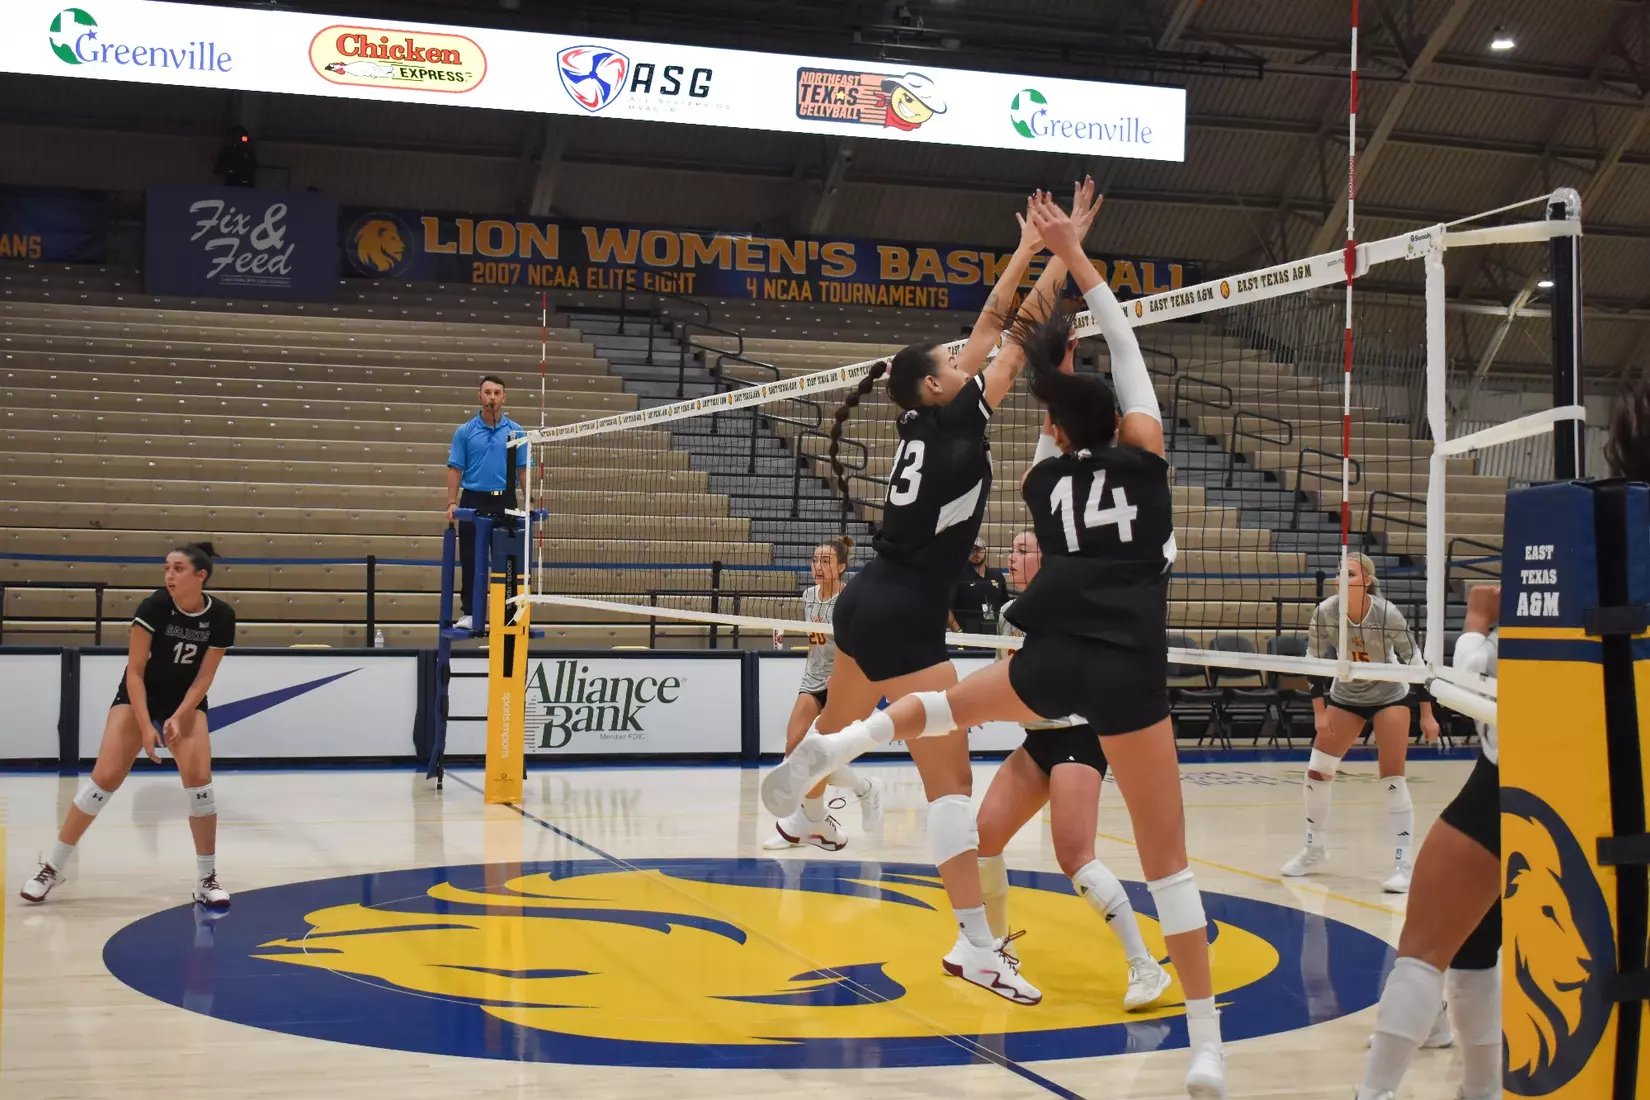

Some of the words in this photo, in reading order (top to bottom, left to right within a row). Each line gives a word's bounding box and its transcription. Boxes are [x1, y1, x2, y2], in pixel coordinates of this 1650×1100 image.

[75, 32, 232, 73] Greenville
[336, 33, 462, 65] Chicken
[400, 67, 464, 82] EXPRESS
[630, 63, 713, 98] ASG
[800, 71, 861, 86] NORTHEAST
[800, 84, 859, 106] TEXAS
[800, 104, 859, 120] GELLYBALL
[1031, 110, 1153, 144] Greenville
[189, 199, 251, 242] Fix
[250, 203, 288, 250] &
[204, 237, 295, 279] Feed
[421, 216, 559, 260] LION
[581, 226, 857, 278] WOMEN'S
[472, 261, 521, 285] 2007
[528, 264, 580, 288] NCAA
[587, 267, 637, 291] ELITE
[643, 271, 697, 294] EIGHT
[746, 276, 757, 299] 4
[764, 278, 813, 301] NCAA
[818, 281, 949, 308] TOURNAMENTS
[1237, 276, 1259, 293] EAST
[1261, 270, 1289, 288] TEXAS
[1292, 264, 1312, 280] A&M
[1149, 299, 1169, 313] EAST
[1170, 291, 1195, 308] TEXAS
[1197, 287, 1214, 302] A&M
[1050, 468, 1138, 553] 14
[1524, 544, 1555, 561] EAST
[1520, 568, 1558, 585] TEXAS
[1516, 591, 1560, 617] A&M
[173, 641, 198, 664] 12
[525, 660, 681, 704] Alliance
[538, 701, 646, 749] Bank
